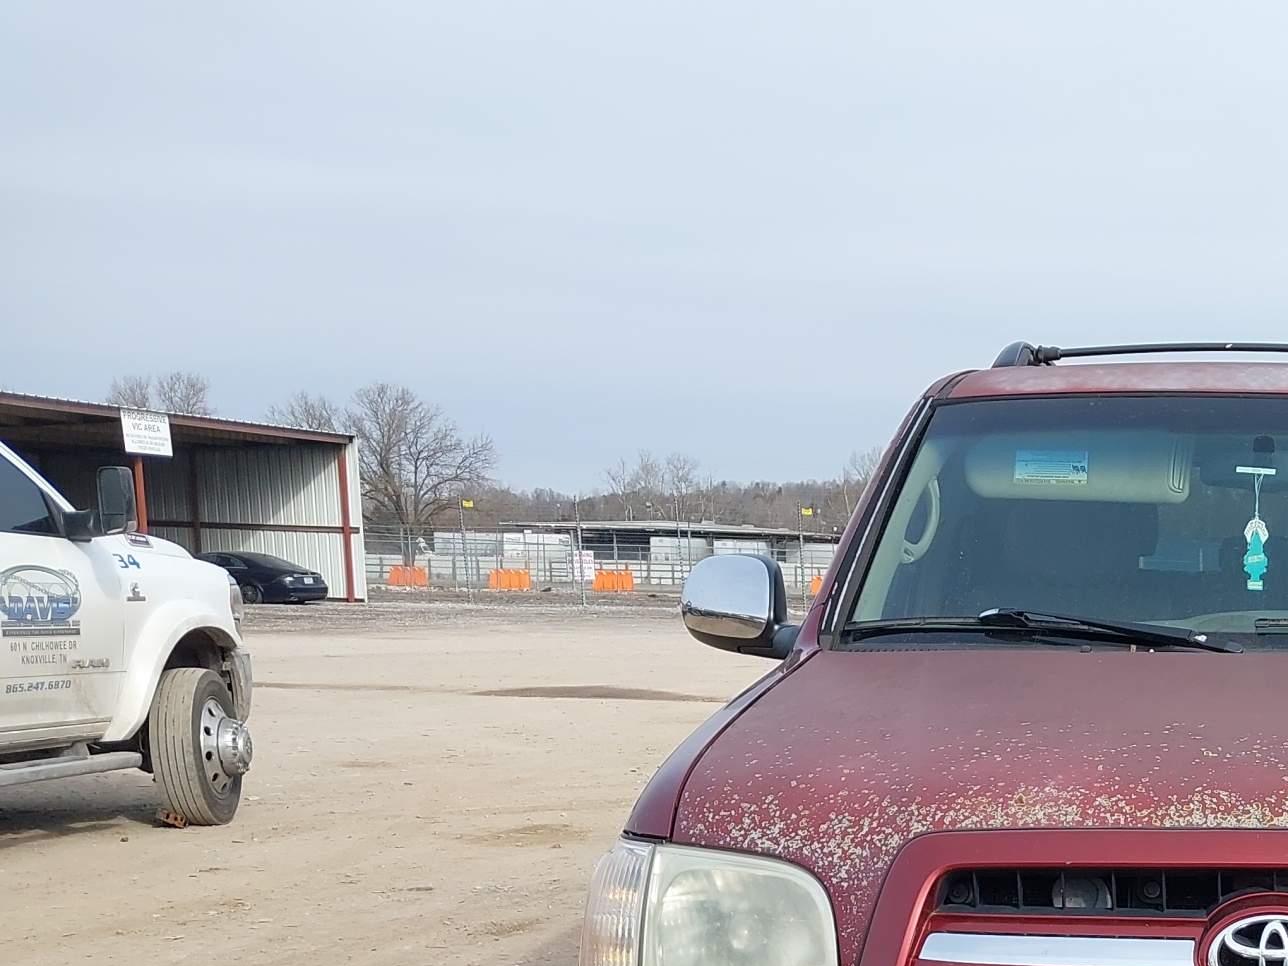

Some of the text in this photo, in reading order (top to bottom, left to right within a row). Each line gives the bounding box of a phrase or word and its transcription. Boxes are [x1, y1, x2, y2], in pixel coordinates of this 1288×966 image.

[112, 553, 141, 569] 34
[22, 641, 28, 651] N
[31, 640, 67, 651] CHILHOWEE
[69, 640, 77, 650] DR
[60, 653, 67, 663] TN
[5, 679, 72, 694] 865.247.6870
